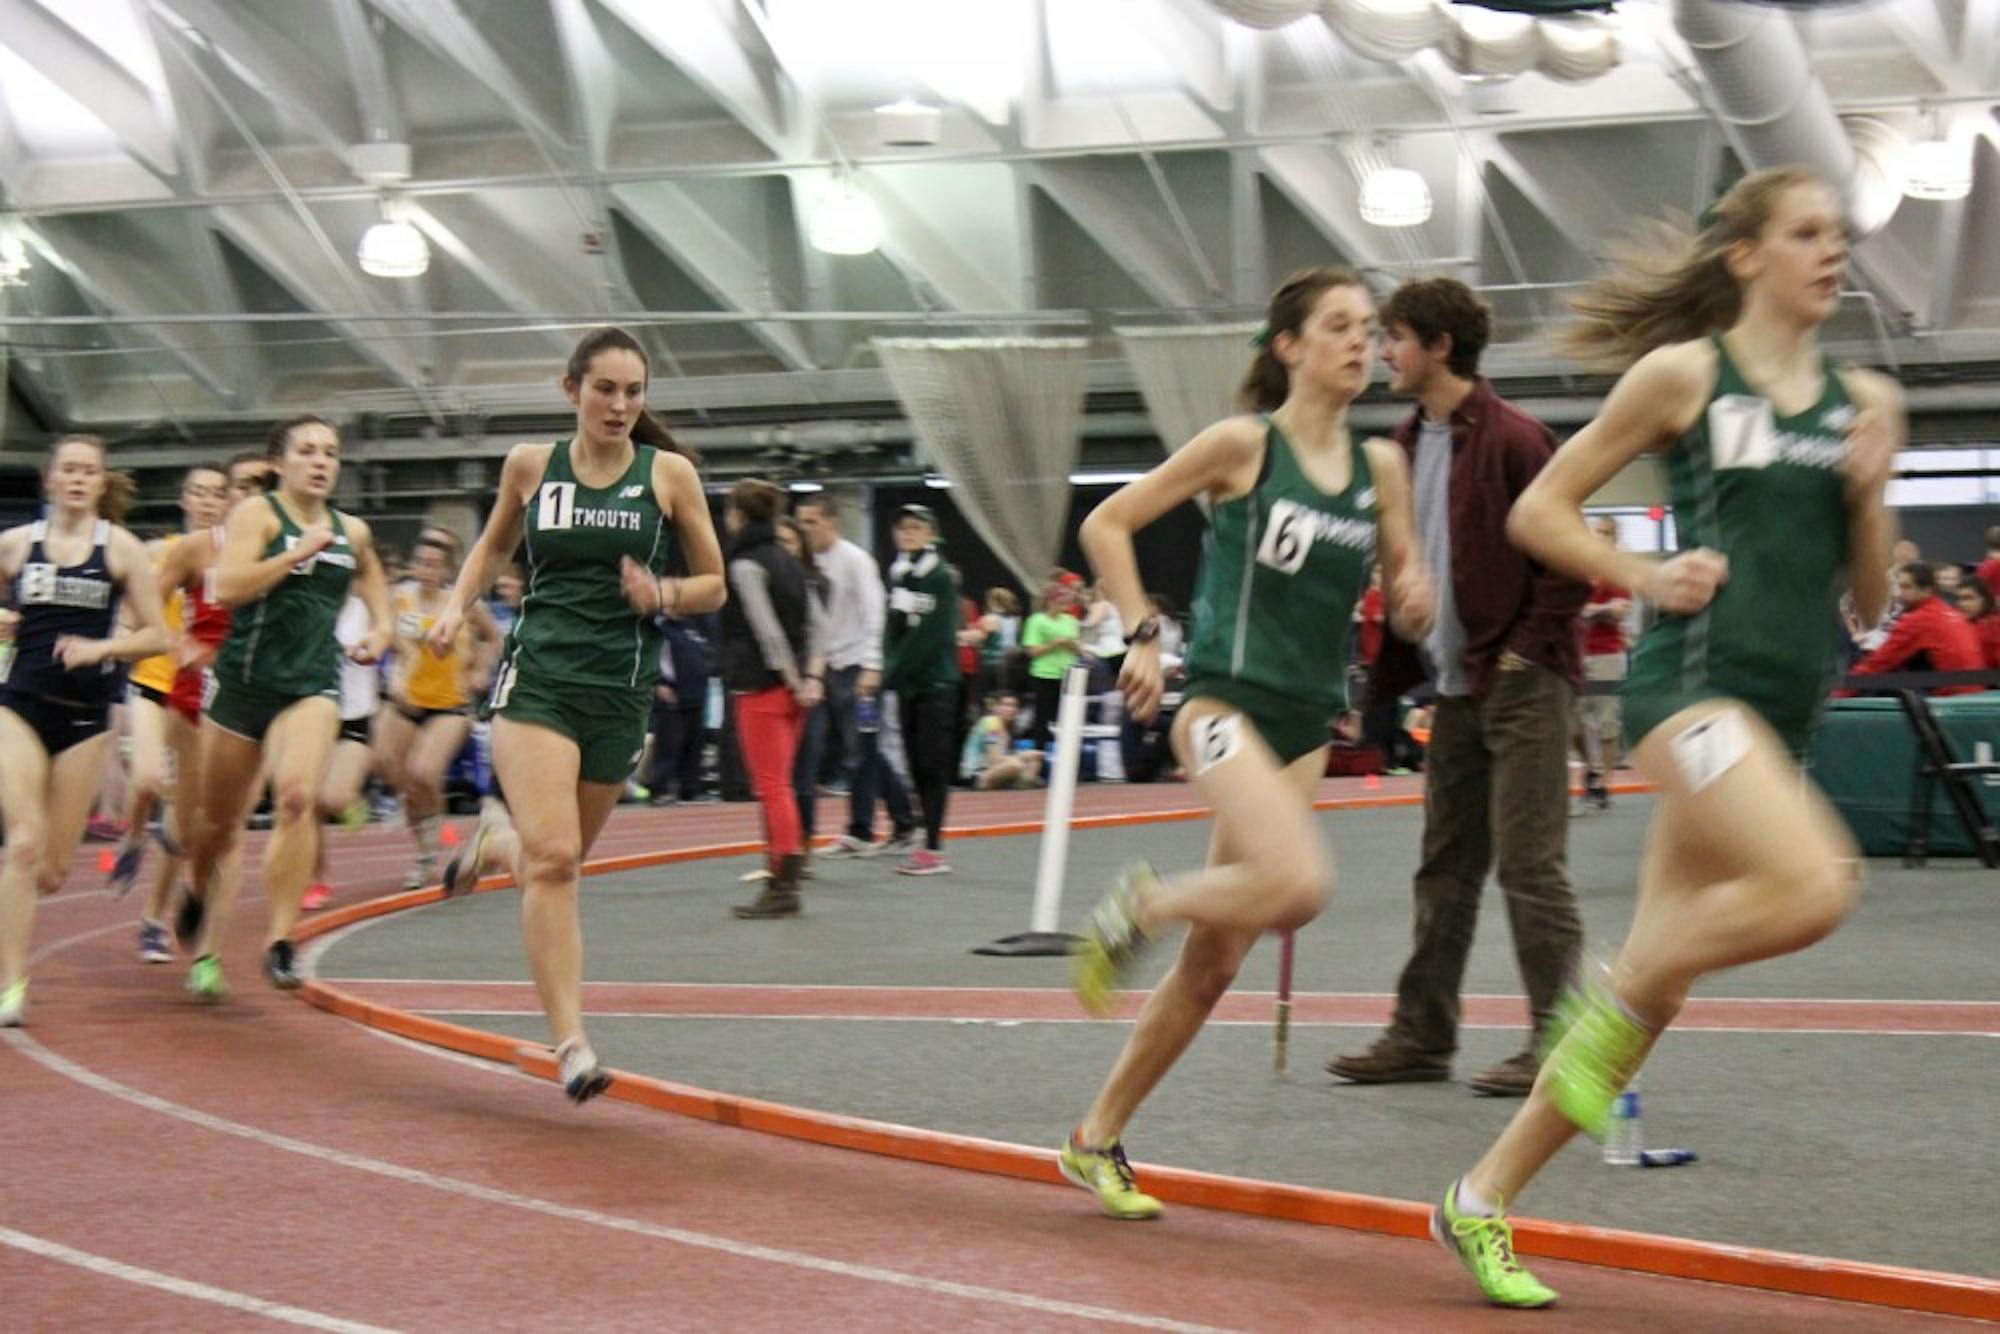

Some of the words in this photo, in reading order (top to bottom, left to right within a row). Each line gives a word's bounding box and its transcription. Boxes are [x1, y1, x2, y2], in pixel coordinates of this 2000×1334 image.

[549, 485, 563, 526] 1
[574, 507, 641, 531] TMOUTH
[1274, 514, 1300, 567] 6
